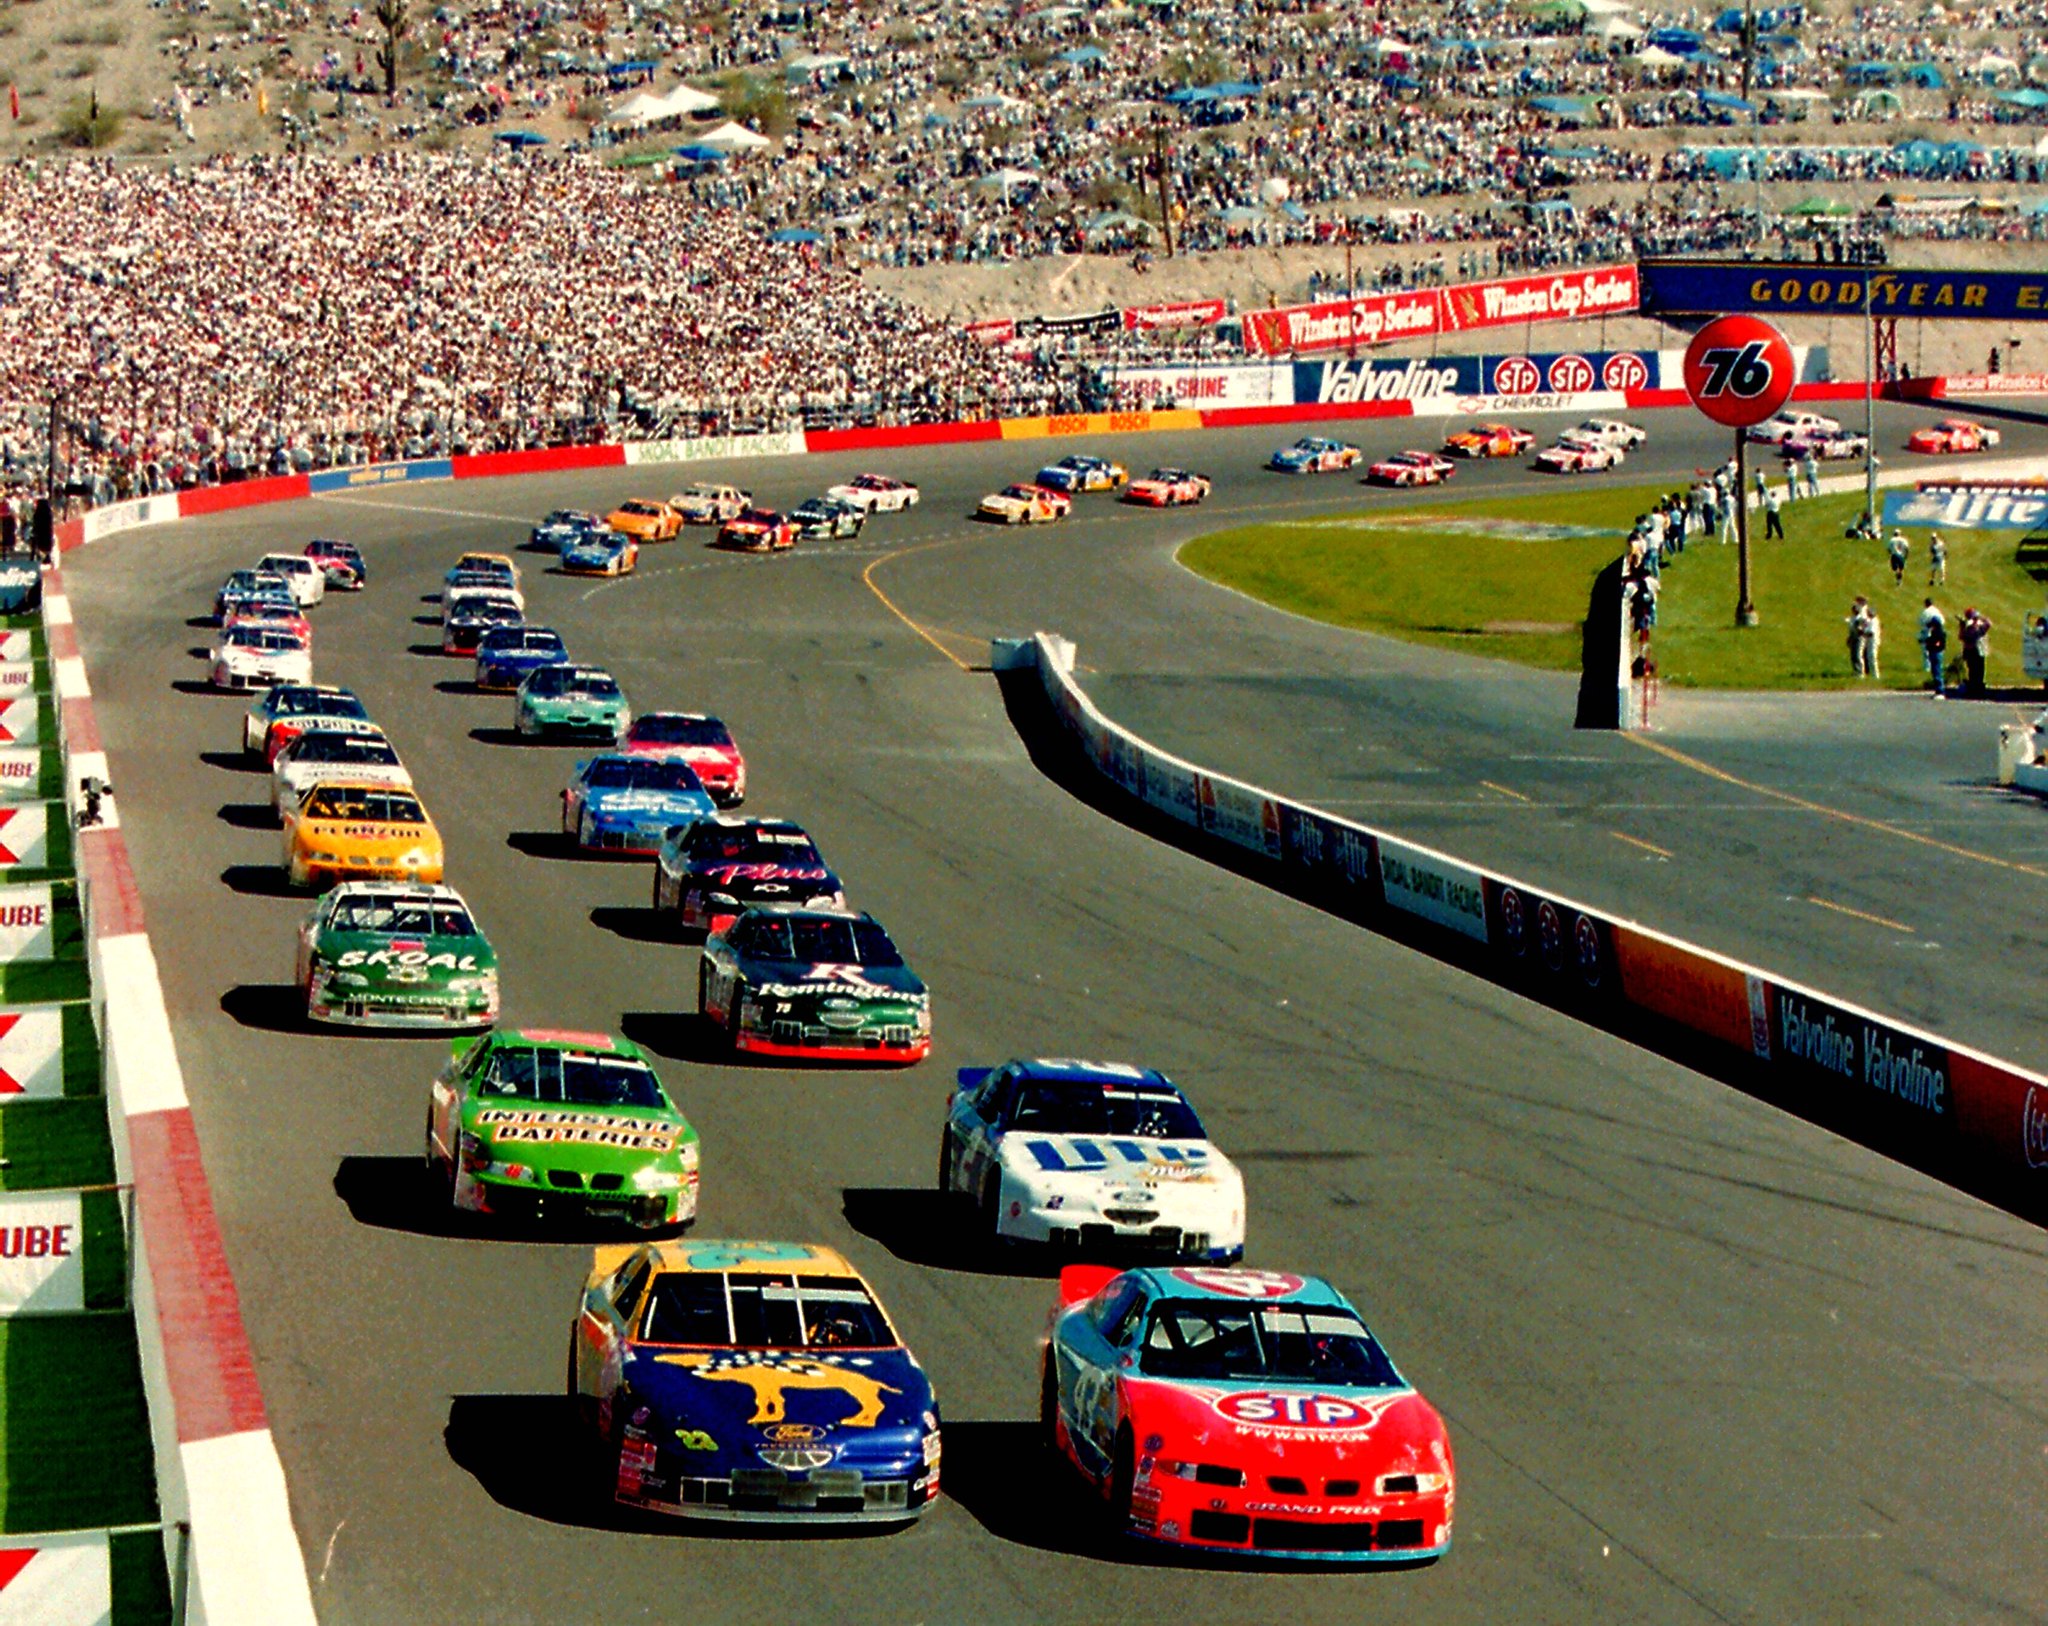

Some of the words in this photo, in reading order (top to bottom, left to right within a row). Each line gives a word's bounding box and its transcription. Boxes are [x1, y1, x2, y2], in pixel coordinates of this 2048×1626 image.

[1483, 284, 1548, 319] Winston
[1550, 279, 1582, 317] Cup
[1583, 275, 1632, 308] Series
[1750, 275, 1988, 309] GOODYEAR
[1288, 312, 1350, 344] Winston
[1351, 302, 1384, 341] Cup
[1385, 300, 1434, 332] Series
[1318, 360, 1458, 403] Valvoline
[1500, 362, 1535, 395] STP
[1554, 361, 1588, 392] STP
[1609, 360, 1642, 390] STP
[1699, 339, 1773, 398] 76
[1175, 375, 1228, 399] SHINE
[1493, 394, 1574, 410] CHEVROLET
[0, 904, 45, 927] UBE
[337, 951, 478, 971] SKOAL
[758, 982, 927, 1004] Remington
[1781, 994, 1854, 1078] Valvoline
[1863, 1026, 1945, 1114] Valvoline
[476, 1109, 684, 1136] INTERSTATE
[493, 1125, 676, 1152] BATTERIES
[0, 1224, 73, 1259] UBE
[1236, 1395, 1358, 1423] STP
[1244, 1501, 1322, 1514] GRAND
[1328, 1504, 1383, 1516] PRIX
